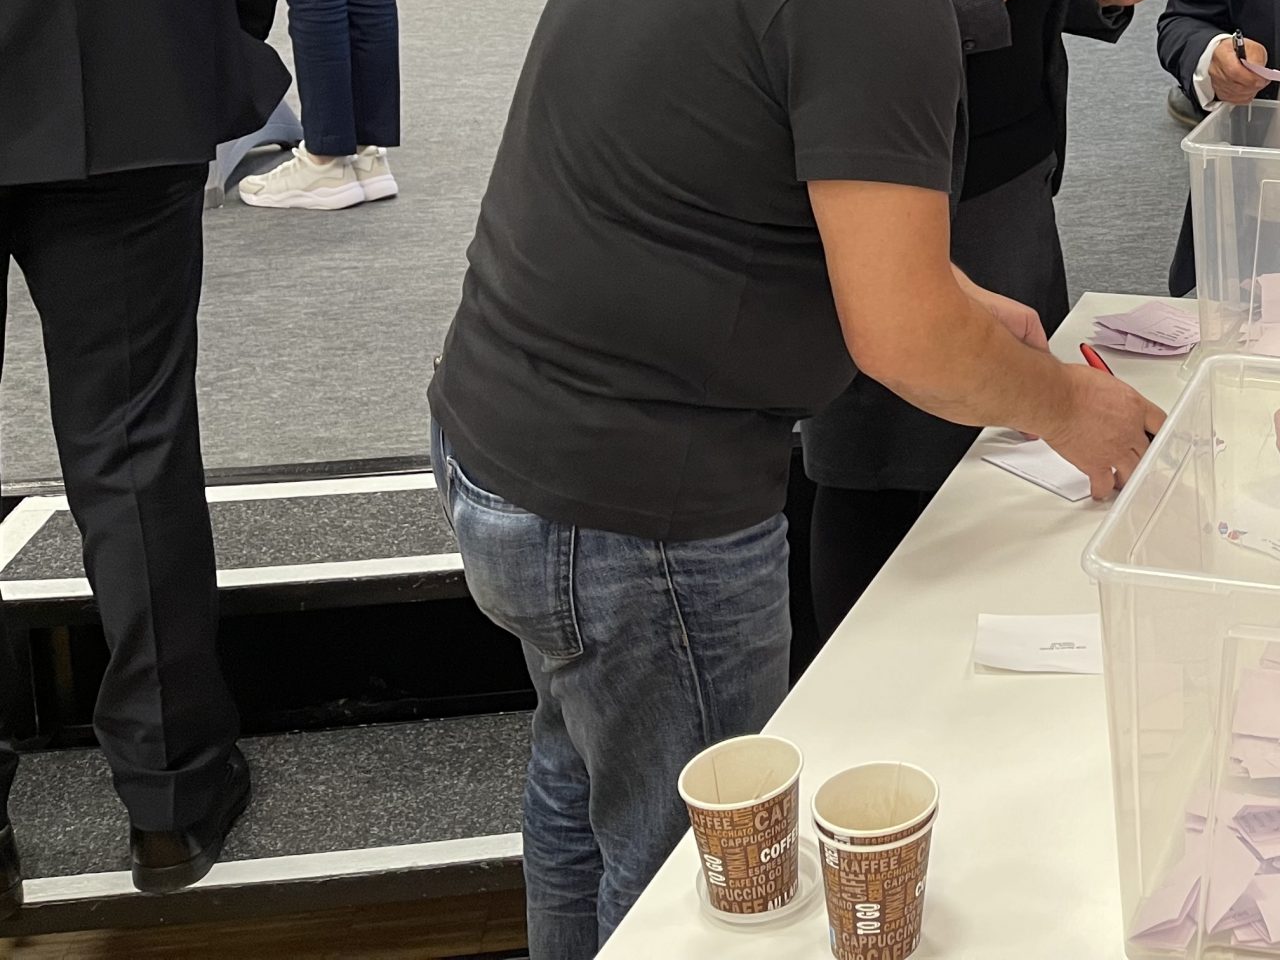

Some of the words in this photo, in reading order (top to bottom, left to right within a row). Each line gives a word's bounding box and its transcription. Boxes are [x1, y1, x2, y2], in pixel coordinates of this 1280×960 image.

[721, 822, 787, 848] CAPPUCCINO
[704, 854, 723, 872] GO
[840, 857, 898, 873] KAFFEE
[708, 871, 727, 887] TO
[753, 874, 766, 886] TO
[769, 867, 782, 880] GO
[855, 903, 881, 919] GO
[857, 921, 881, 935] TO
